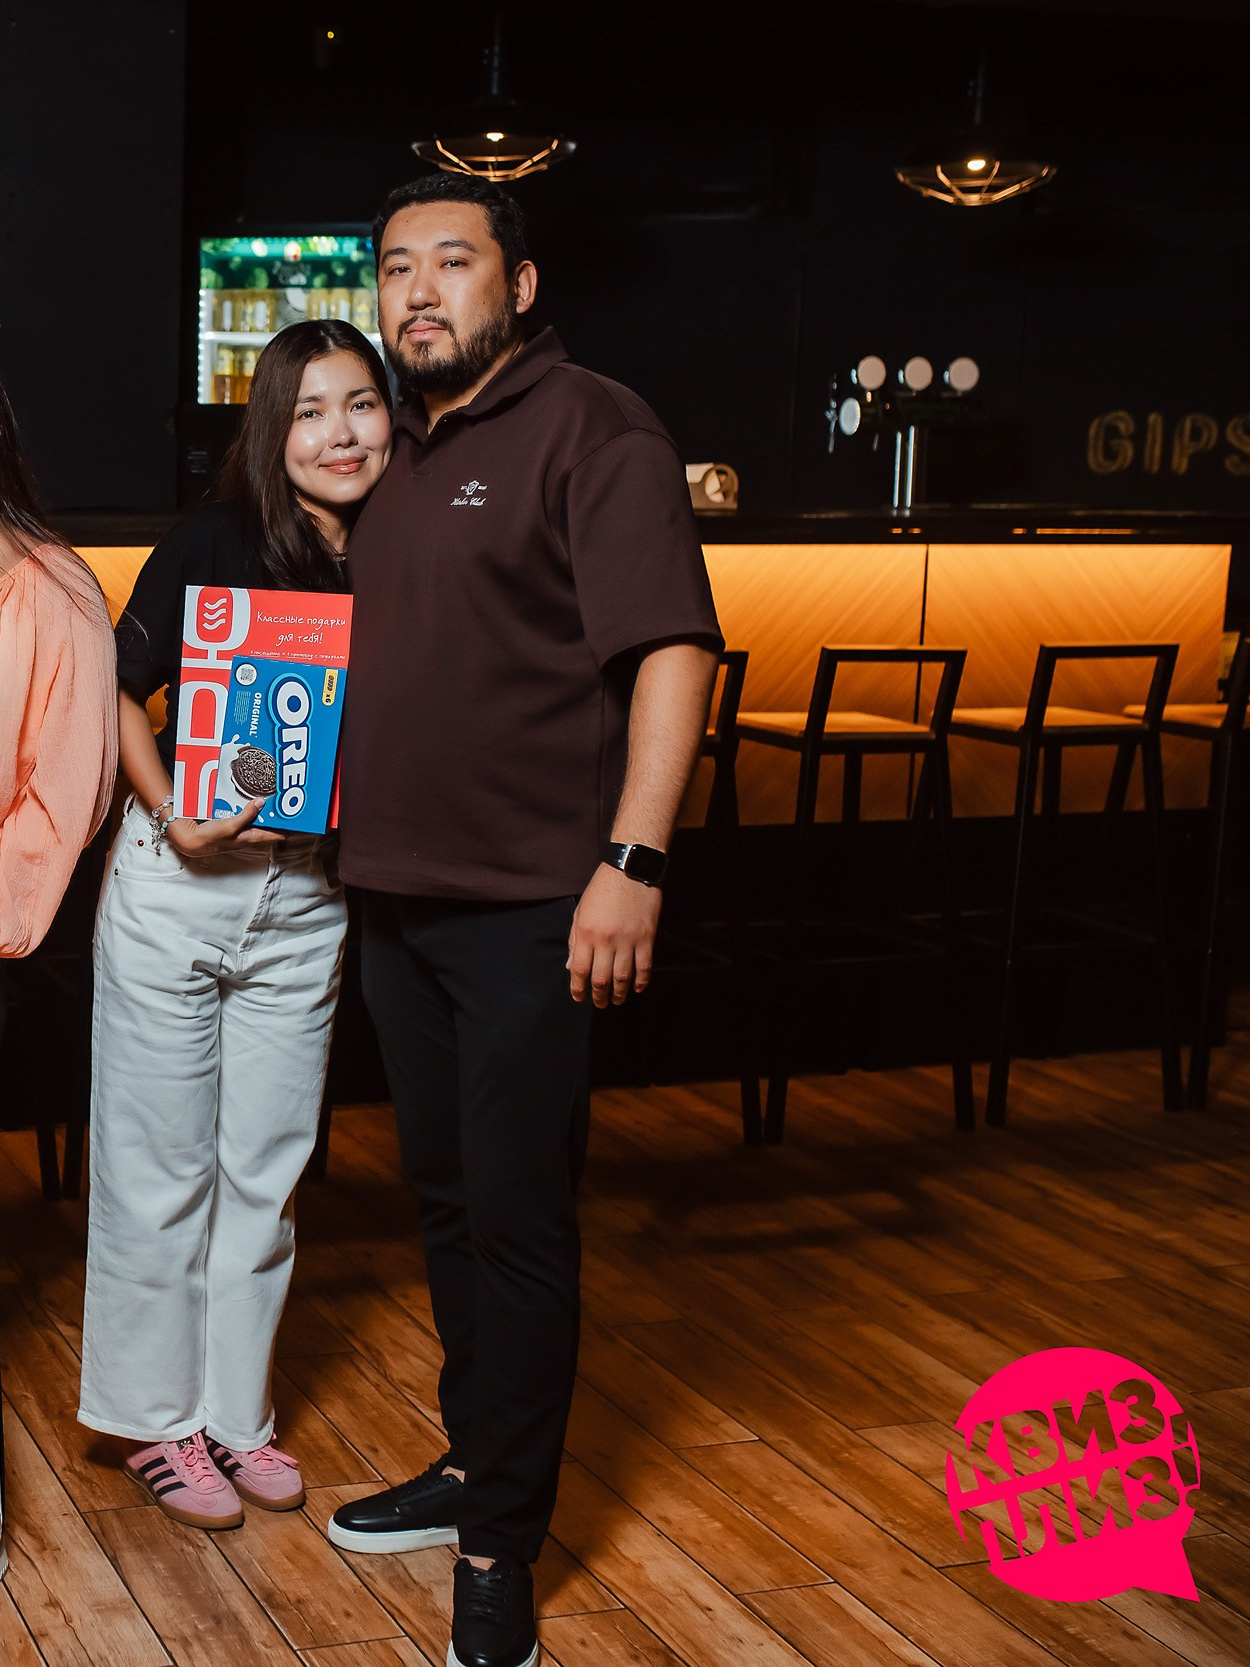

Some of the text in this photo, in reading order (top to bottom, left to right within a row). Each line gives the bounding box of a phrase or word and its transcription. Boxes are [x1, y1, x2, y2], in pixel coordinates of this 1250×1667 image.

[256, 611, 346, 631] Классные подарки
[275, 632, 323, 647] для тебя!
[249, 692, 262, 737] ORIGINAL
[276, 681, 310, 815] OREO
